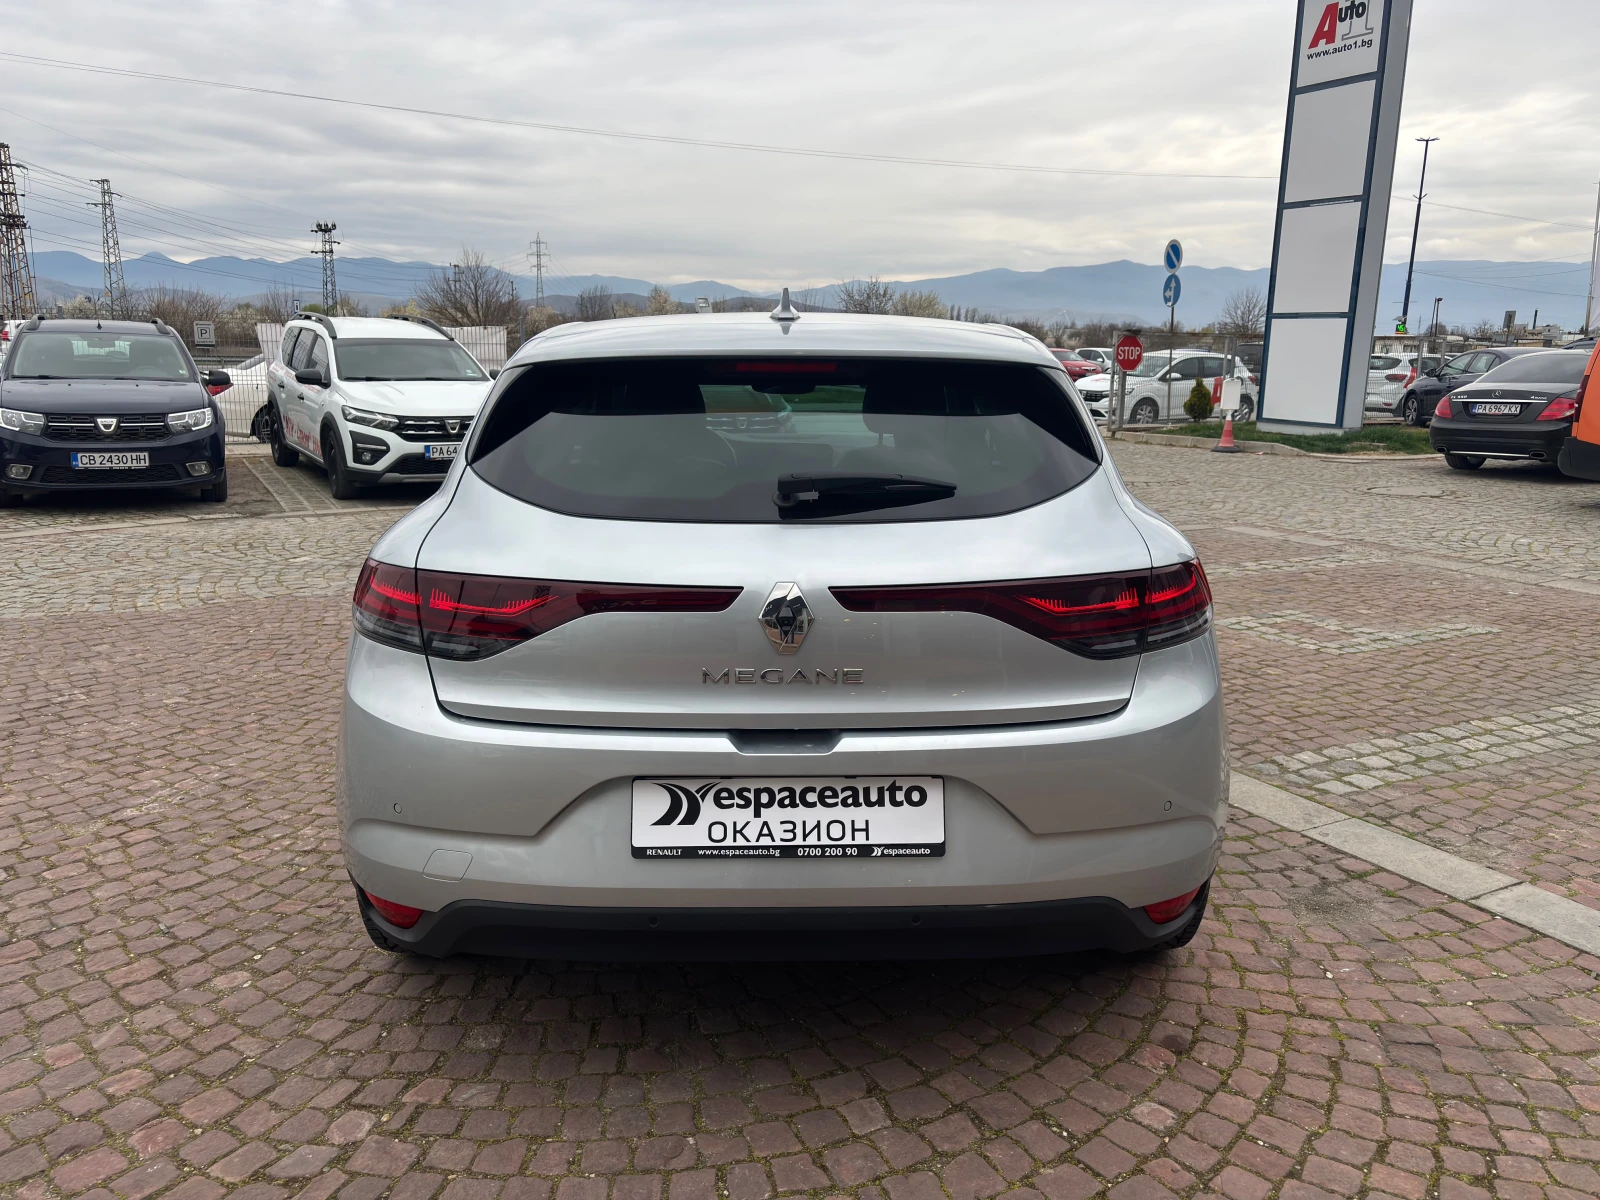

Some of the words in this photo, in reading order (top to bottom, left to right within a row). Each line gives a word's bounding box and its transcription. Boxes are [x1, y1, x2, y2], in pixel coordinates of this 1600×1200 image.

[1308, 1, 1366, 49] Auto
[1307, 39, 1373, 60] www.auto1.bg
[1118, 346, 1141, 360] STOP
[1476, 404, 1487, 413] PA
[1488, 404, 1507, 413] 6967
[1508, 404, 1520, 413] KX
[431, 446, 445, 456] PA
[446, 446, 458, 456] 64
[80, 454, 97, 466] CB
[98, 454, 128, 466] 2430
[130, 453, 147, 465] HH
[702, 668, 864, 684] MEGANE
[712, 779, 928, 818] espaceauto
[707, 819, 870, 843] ОКАЗИОН
[698, 848, 780, 857] www.espaceauto.bg
[797, 847, 822, 856] 0700
[824, 847, 843, 856] 200
[845, 847, 858, 856] 90
[883, 847, 931, 857] espaceauto
